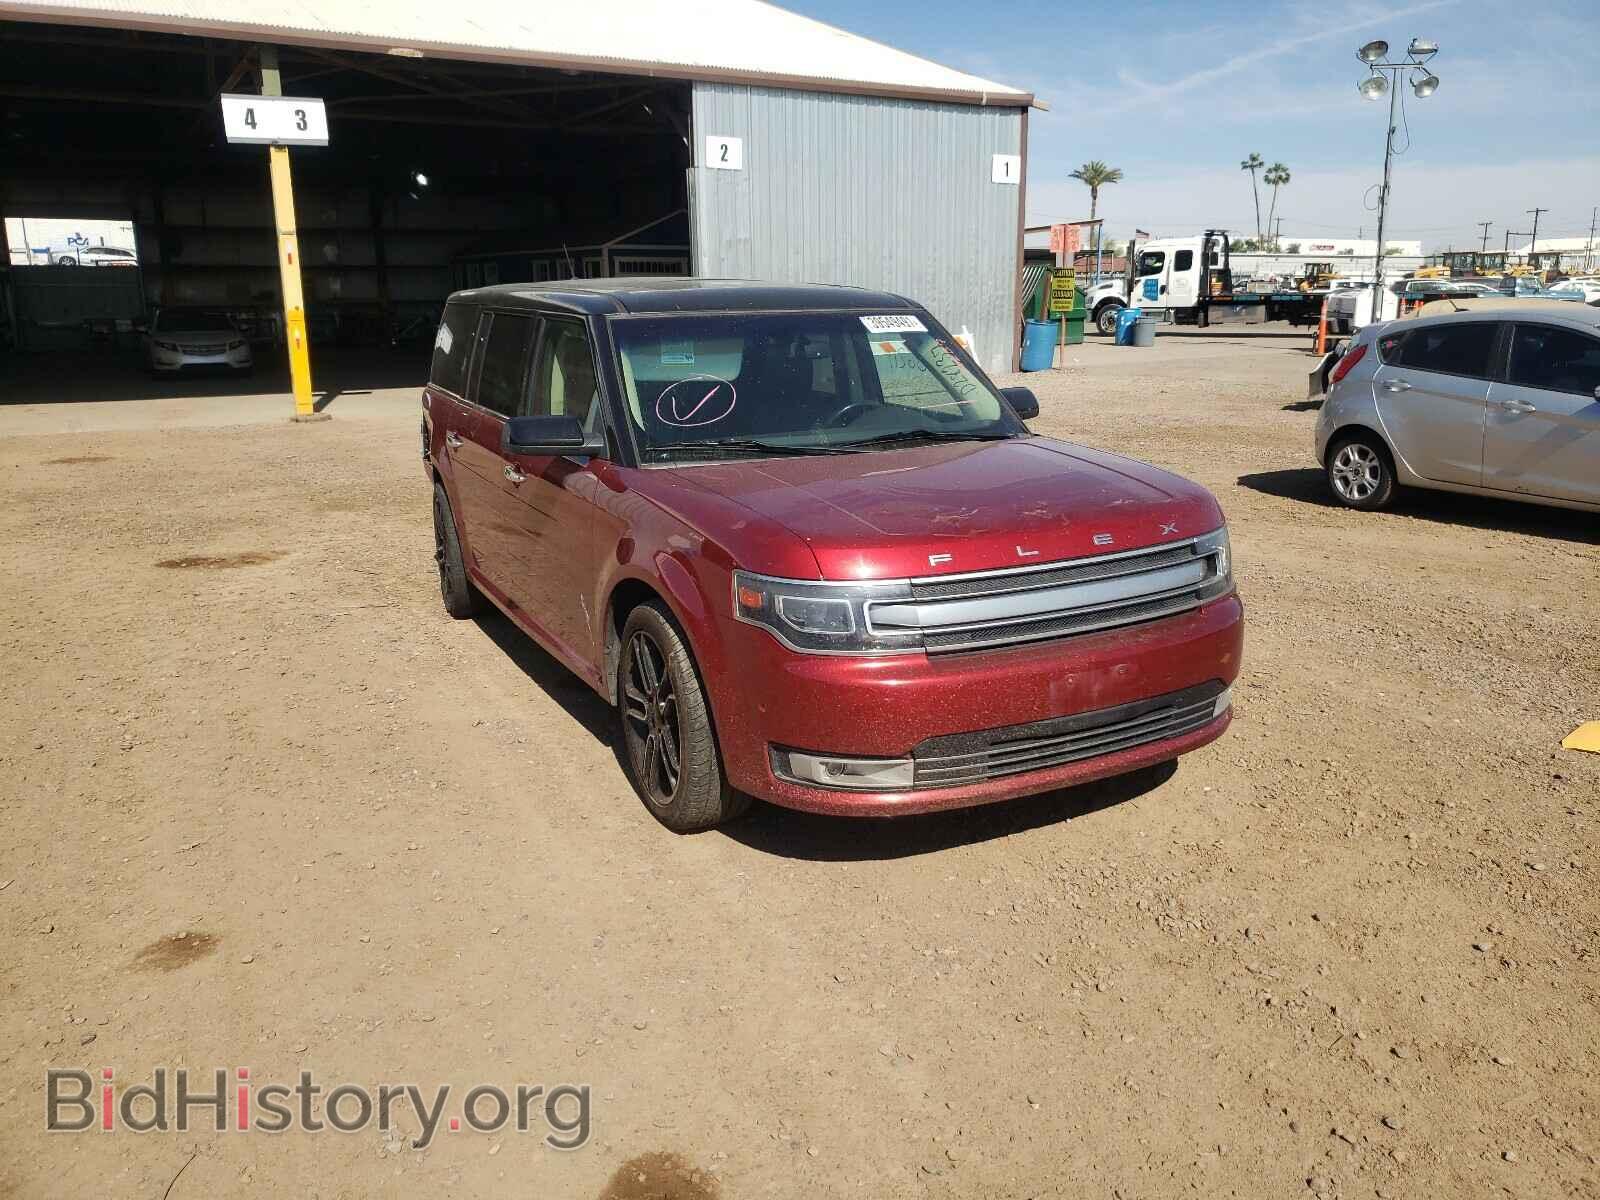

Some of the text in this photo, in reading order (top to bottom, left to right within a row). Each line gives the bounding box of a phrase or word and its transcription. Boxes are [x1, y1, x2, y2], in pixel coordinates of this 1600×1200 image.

[245, 107, 308, 131] 4 3
[719, 143, 728, 163] 2
[1003, 161, 1010, 178] 1
